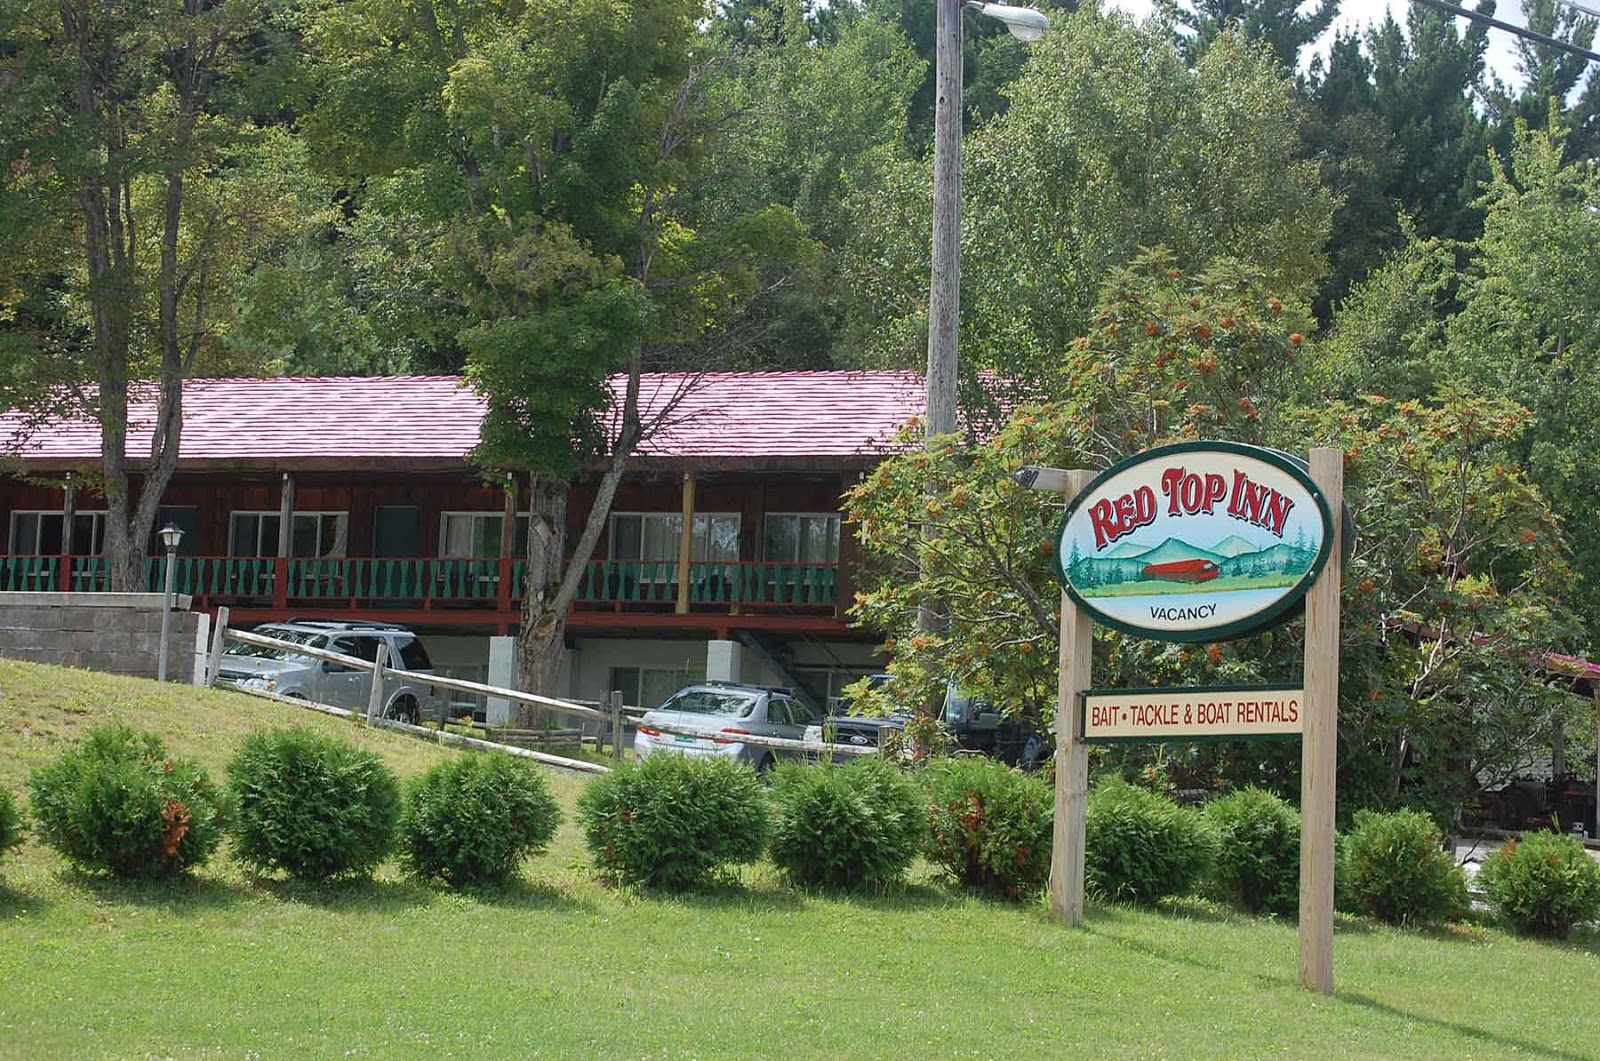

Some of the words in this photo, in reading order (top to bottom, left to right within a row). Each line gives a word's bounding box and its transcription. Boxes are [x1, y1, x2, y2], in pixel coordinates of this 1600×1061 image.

[1226, 468, 1294, 538] INN
[1150, 603, 1217, 622] VACANCY
[1092, 707, 1120, 726] BAIT
[1130, 704, 1179, 726] TACKLE
[1183, 704, 1193, 725] &
[1197, 702, 1232, 725] BOAT
[1237, 699, 1298, 724] RENTALS
